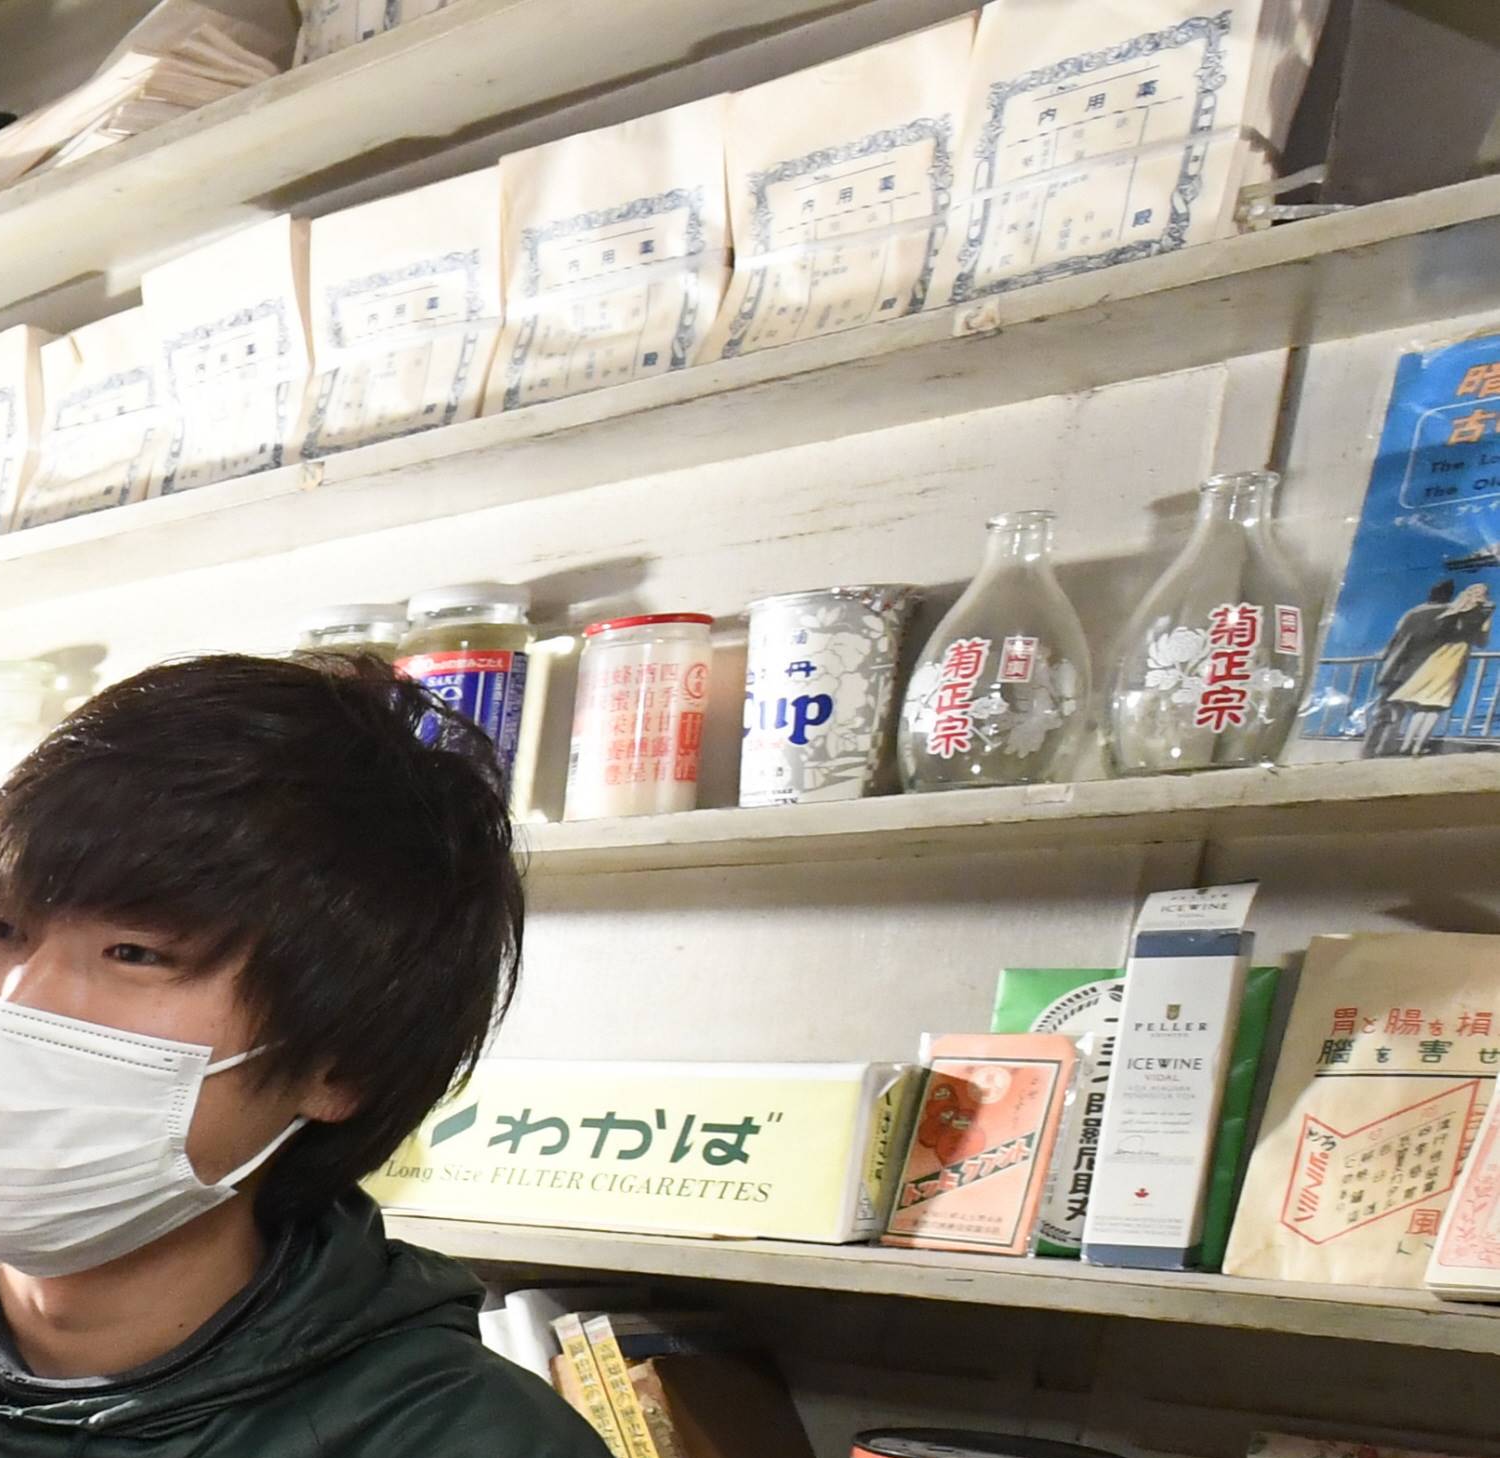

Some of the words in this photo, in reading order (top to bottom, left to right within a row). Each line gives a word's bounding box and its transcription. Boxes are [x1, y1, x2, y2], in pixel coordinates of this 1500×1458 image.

[1195, 602, 1264, 732] 菊正宗
[928, 637, 992, 759] 菊正宗
[1134, 1022, 1209, 1032] PELLER
[1331, 1007, 1500, 1037] 胃と腸を損
[1126, 1057, 1203, 1071] ICEWINE
[488, 1107, 762, 1166] わかば
[386, 1159, 434, 1183] Long
[489, 1166, 583, 1191] FILTER
[589, 1174, 773, 1203] CIGARETTES
